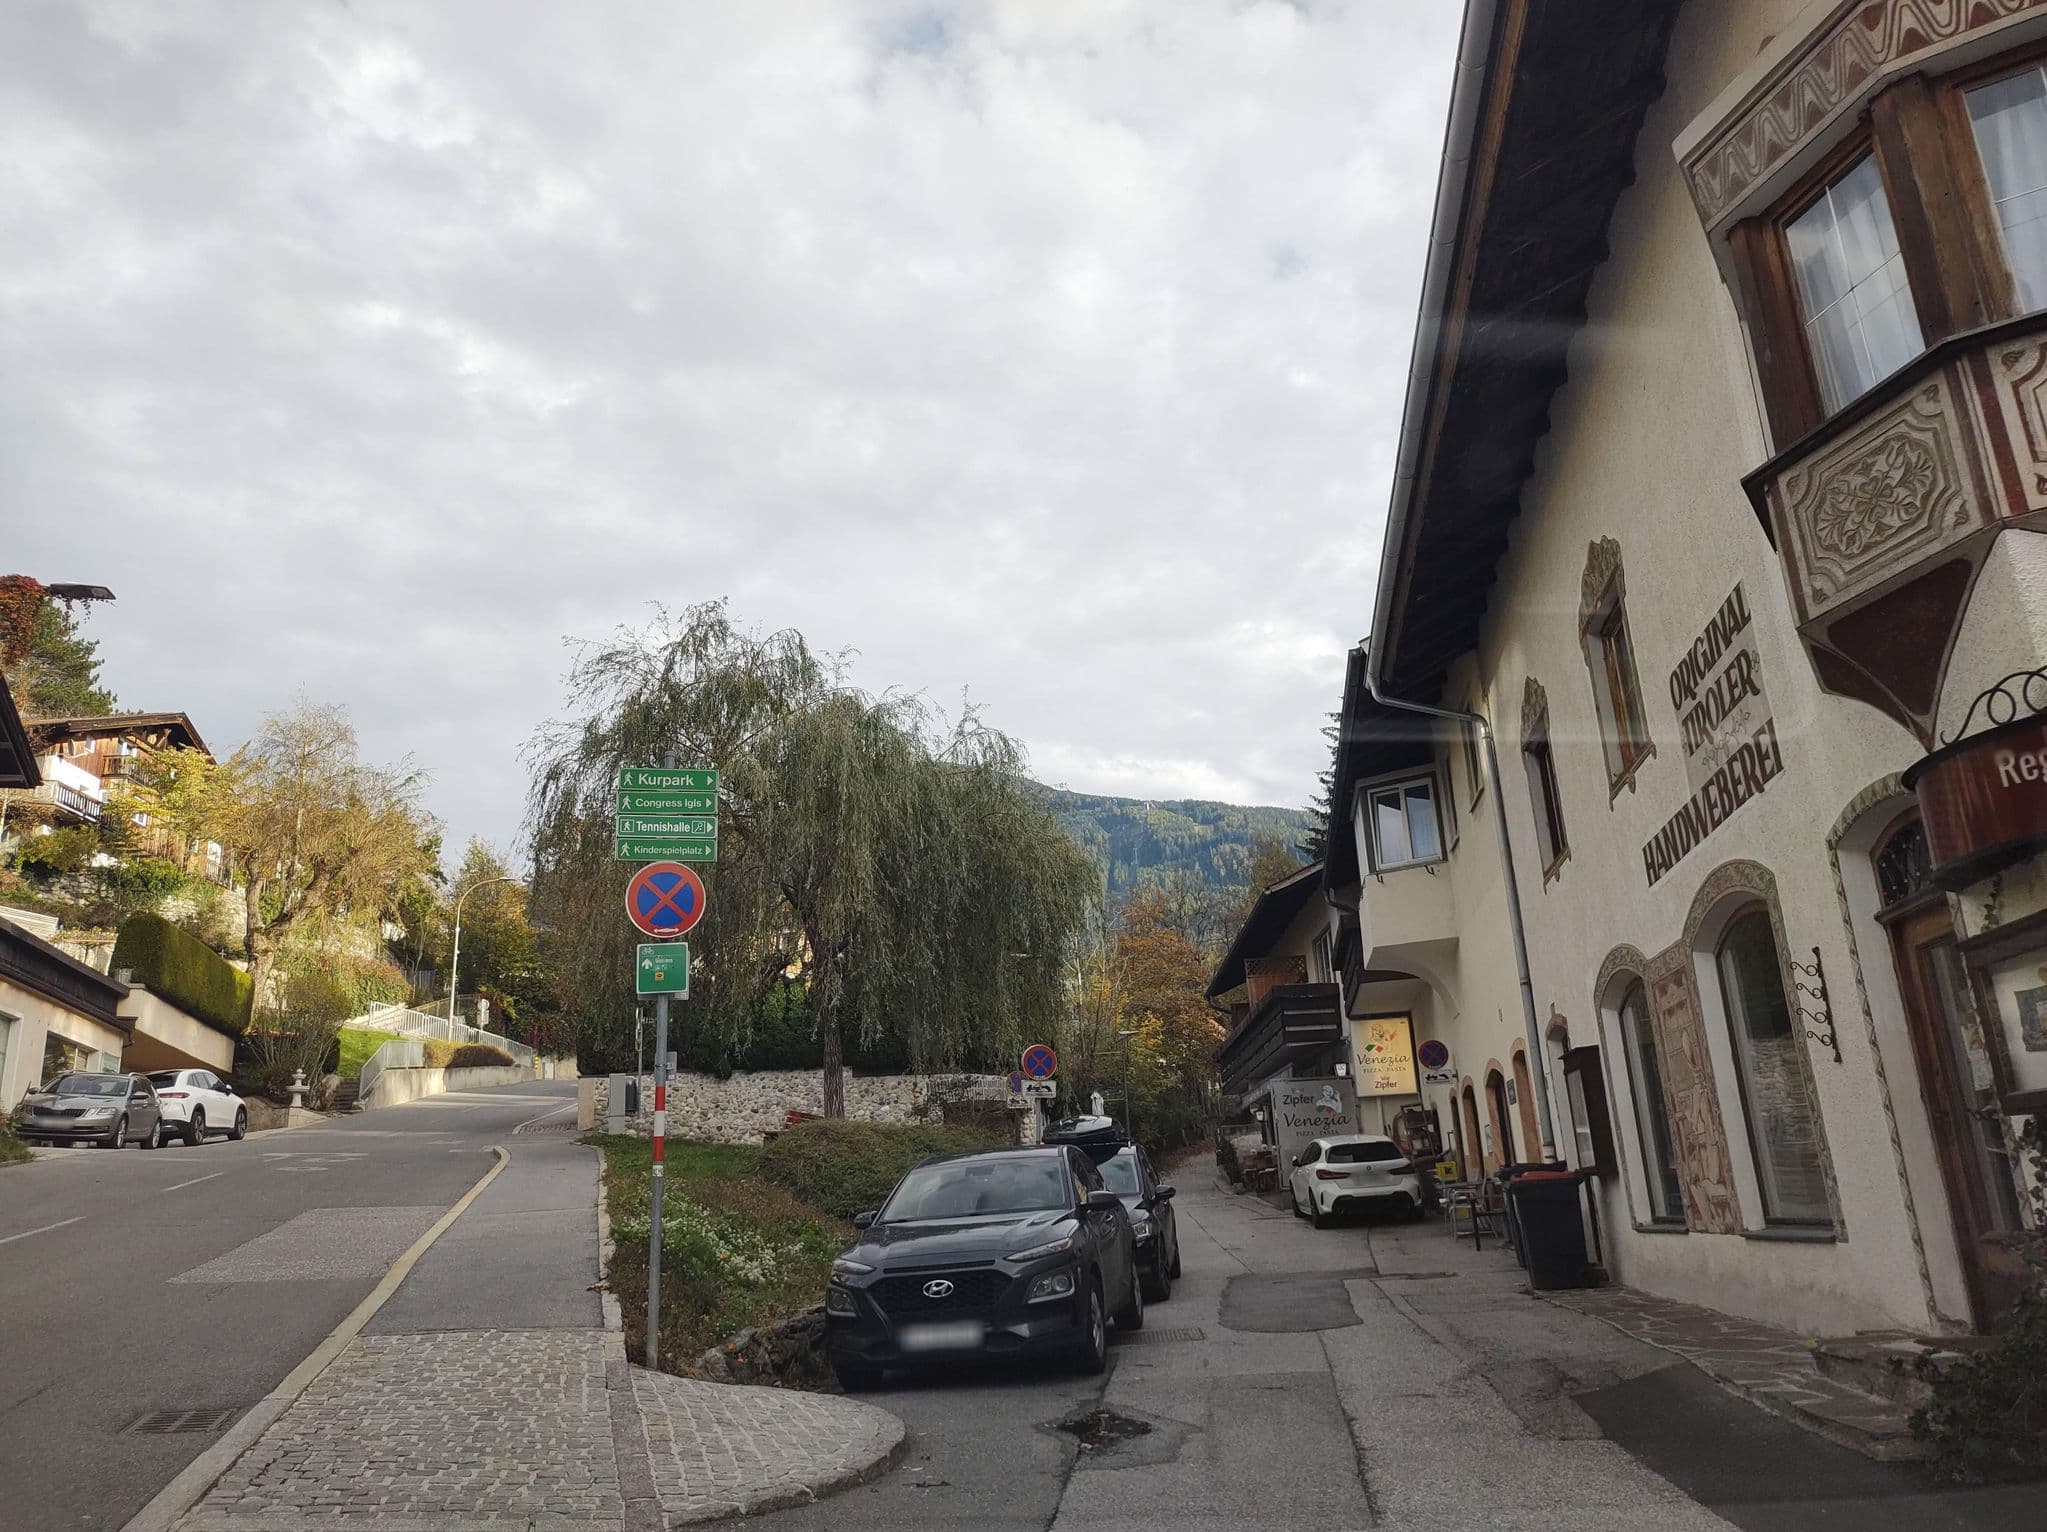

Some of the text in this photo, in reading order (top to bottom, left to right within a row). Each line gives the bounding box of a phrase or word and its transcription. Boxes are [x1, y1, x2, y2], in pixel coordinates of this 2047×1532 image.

[1669, 579, 1751, 711] ORIGINAL
[1682, 648, 1760, 757] TIROLER
[638, 773, 694, 788] Kurpark
[635, 798, 702, 809] Congress Igls
[1642, 717, 1784, 888] HANDWEBEREI
[636, 821, 690, 833] Tennishalle
[634, 845, 703, 856] Kinderspielplatz
[1357, 1053, 1410, 1067] Venezia
[1374, 1080, 1398, 1091] Zipfer
[1282, 1094, 1315, 1108] Zipfer
[1284, 1113, 1352, 1130] Venezia
